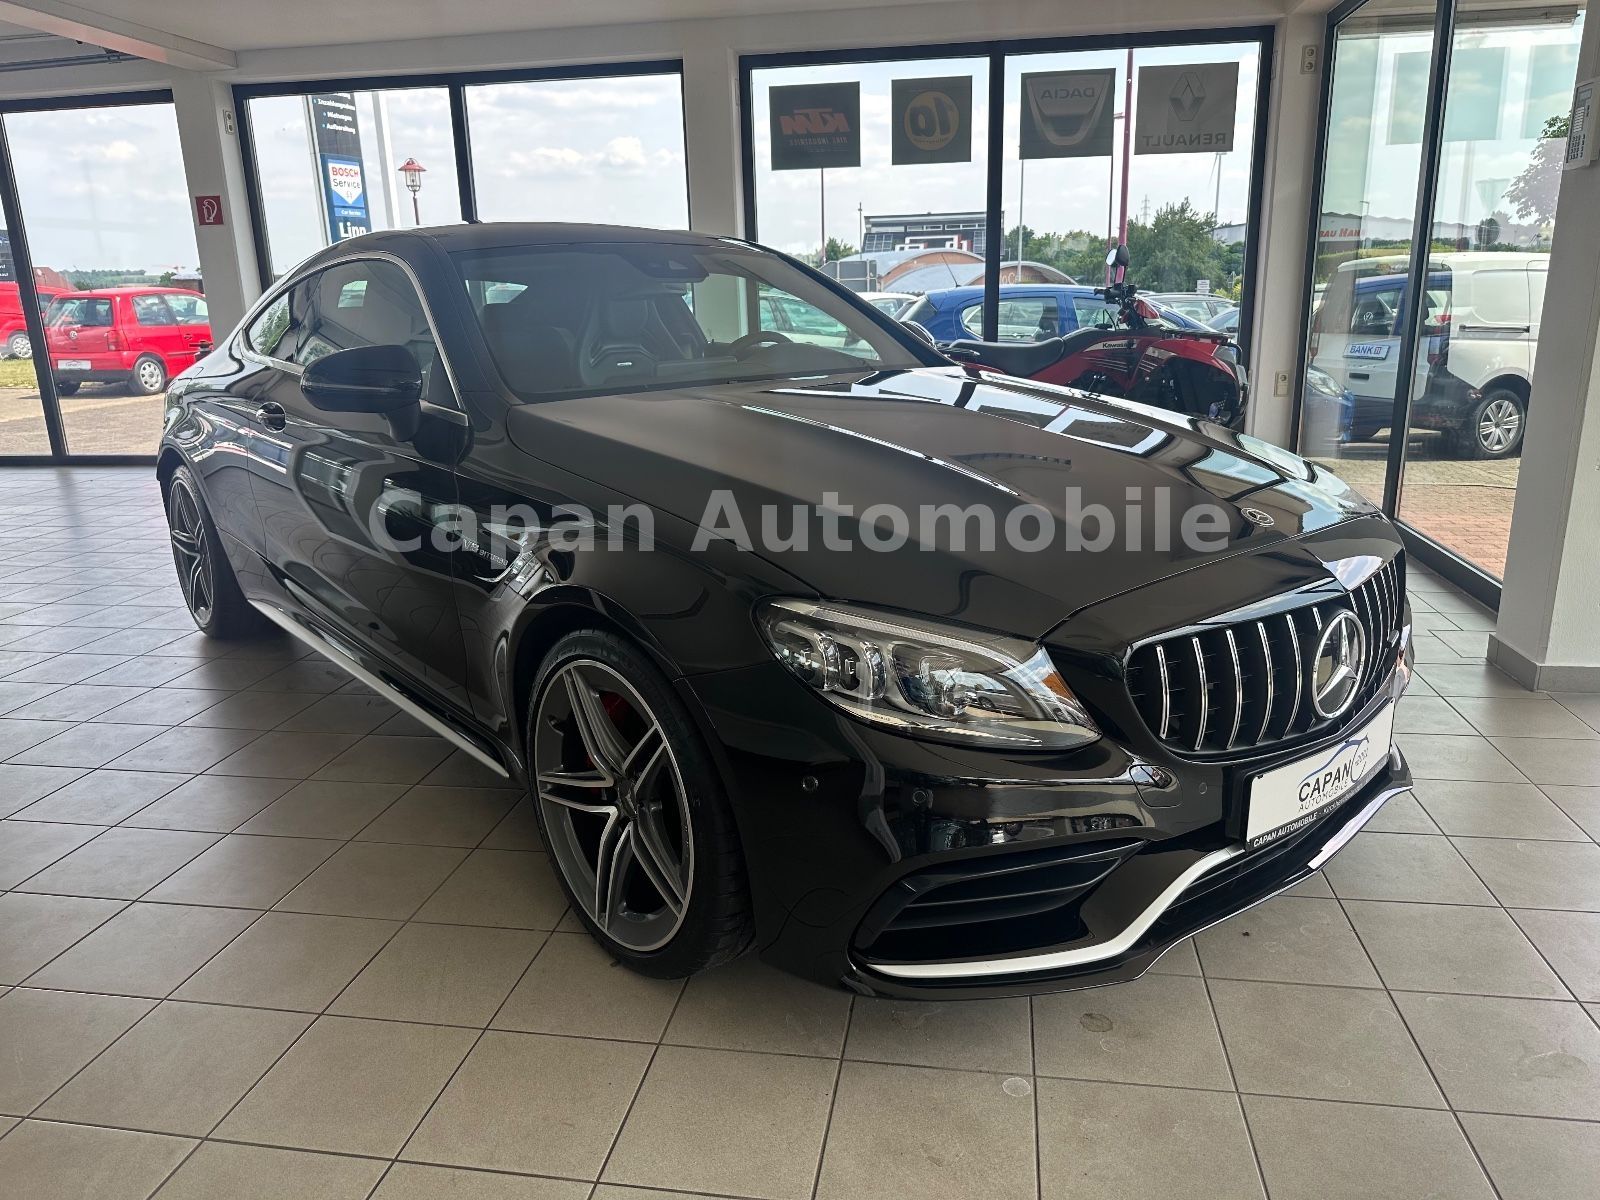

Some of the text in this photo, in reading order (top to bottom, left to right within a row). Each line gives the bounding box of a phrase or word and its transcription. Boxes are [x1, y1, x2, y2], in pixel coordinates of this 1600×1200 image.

[331, 166, 359, 178] BOSCH
[333, 178, 361, 189] Service
[1350, 345, 1374, 354] BANK
[1298, 759, 1352, 802] CAPAN
[1298, 778, 1349, 812] AUTOMOBILE
[1253, 832, 1277, 847] CAPAN
[1277, 812, 1318, 838] AUTOMOBILE
